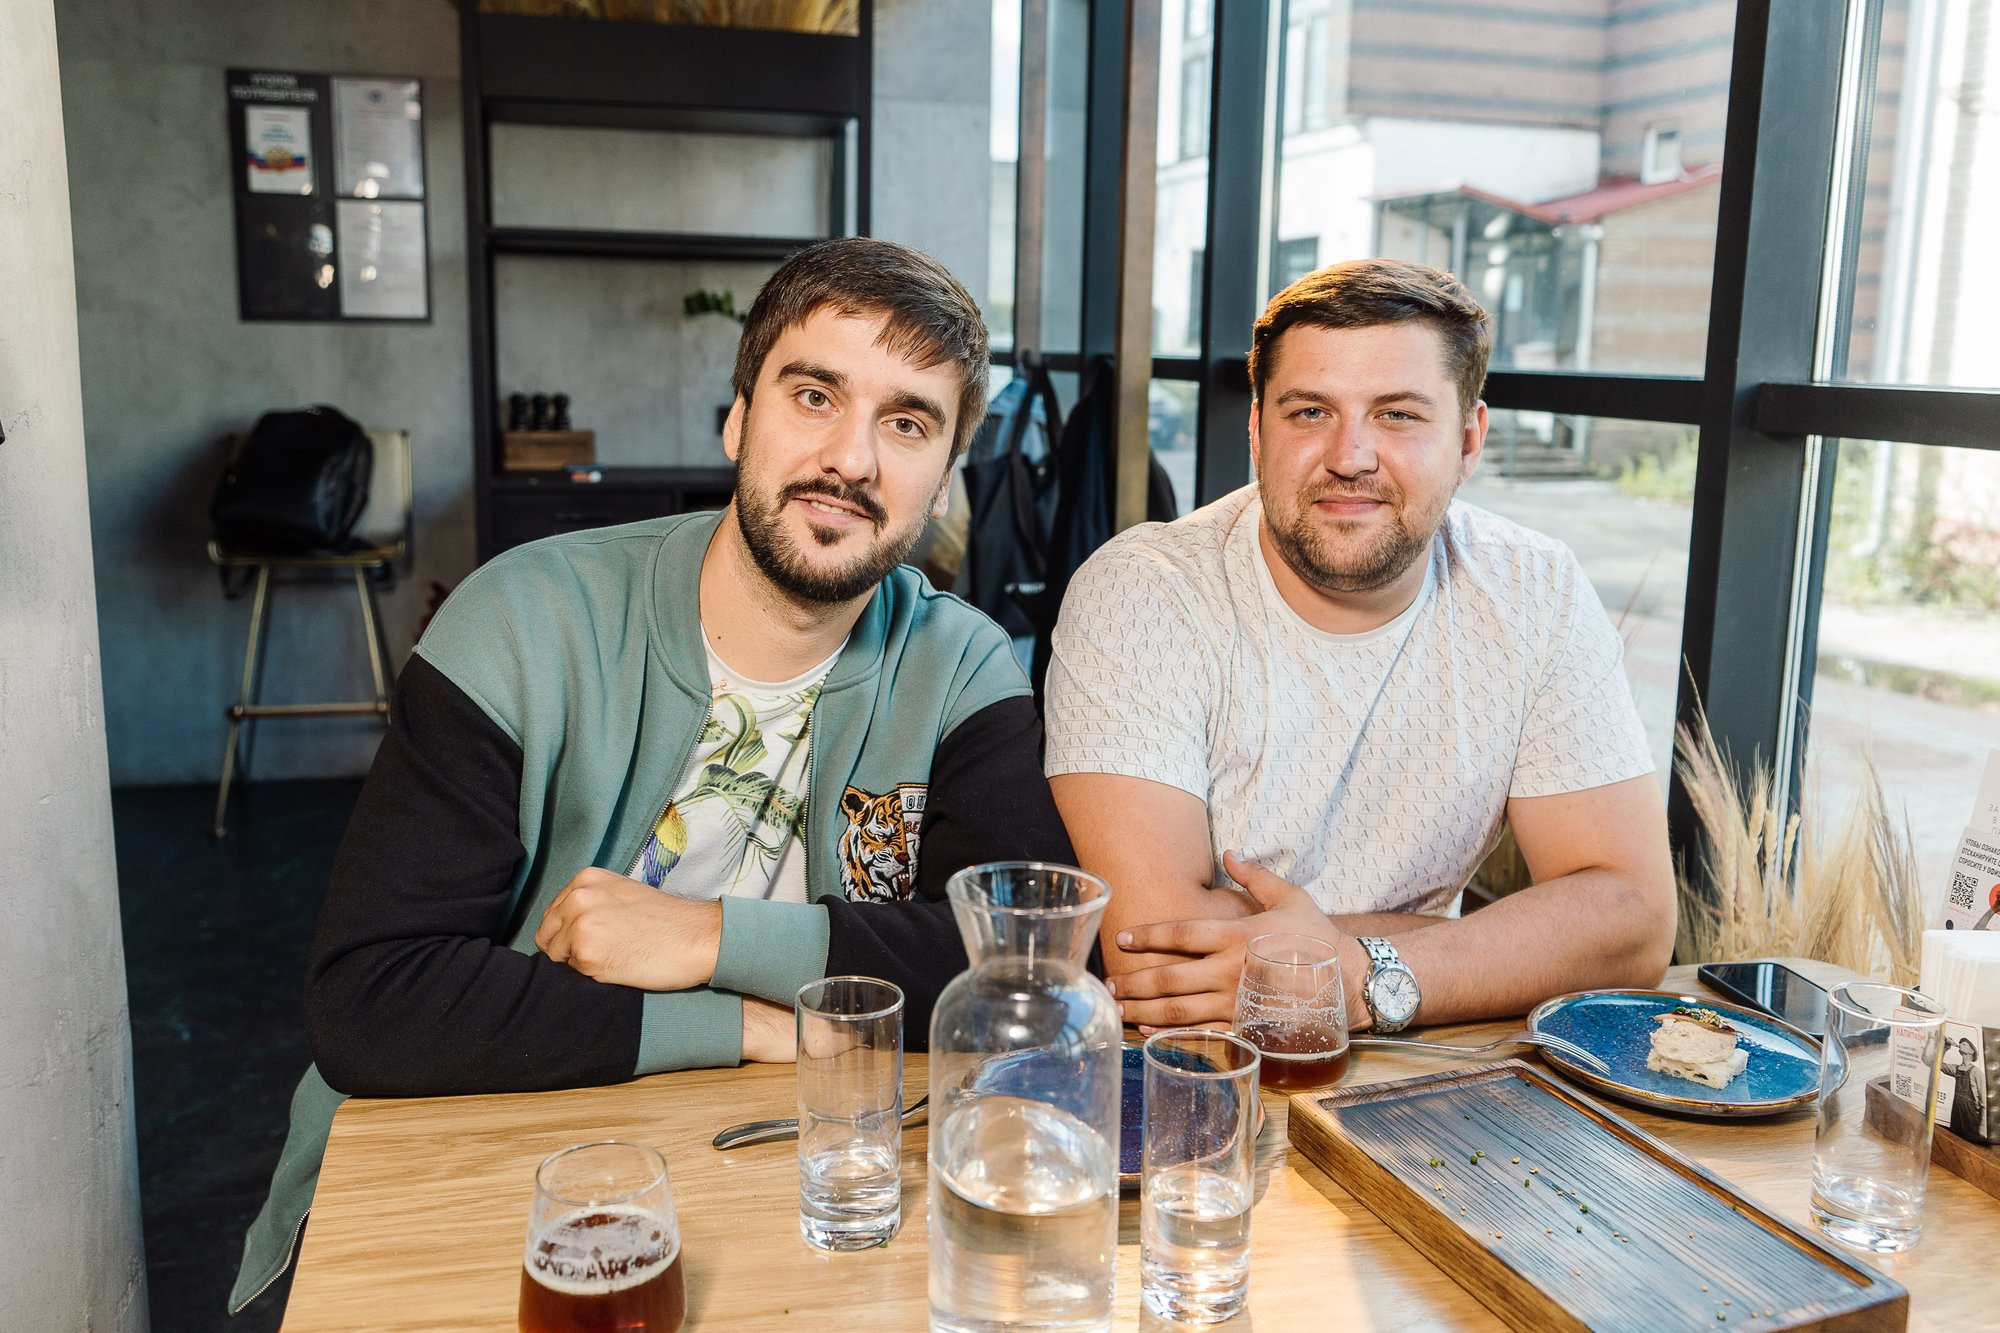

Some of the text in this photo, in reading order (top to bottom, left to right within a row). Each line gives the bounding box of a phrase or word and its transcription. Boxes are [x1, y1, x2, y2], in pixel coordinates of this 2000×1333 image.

[1966, 838, 1982, 848] ЧТОБЫ
[1958, 856, 1982, 871] СПРОСИТЕ
[1962, 847, 1997, 866] ОТСКАНИРУЙТЕ
